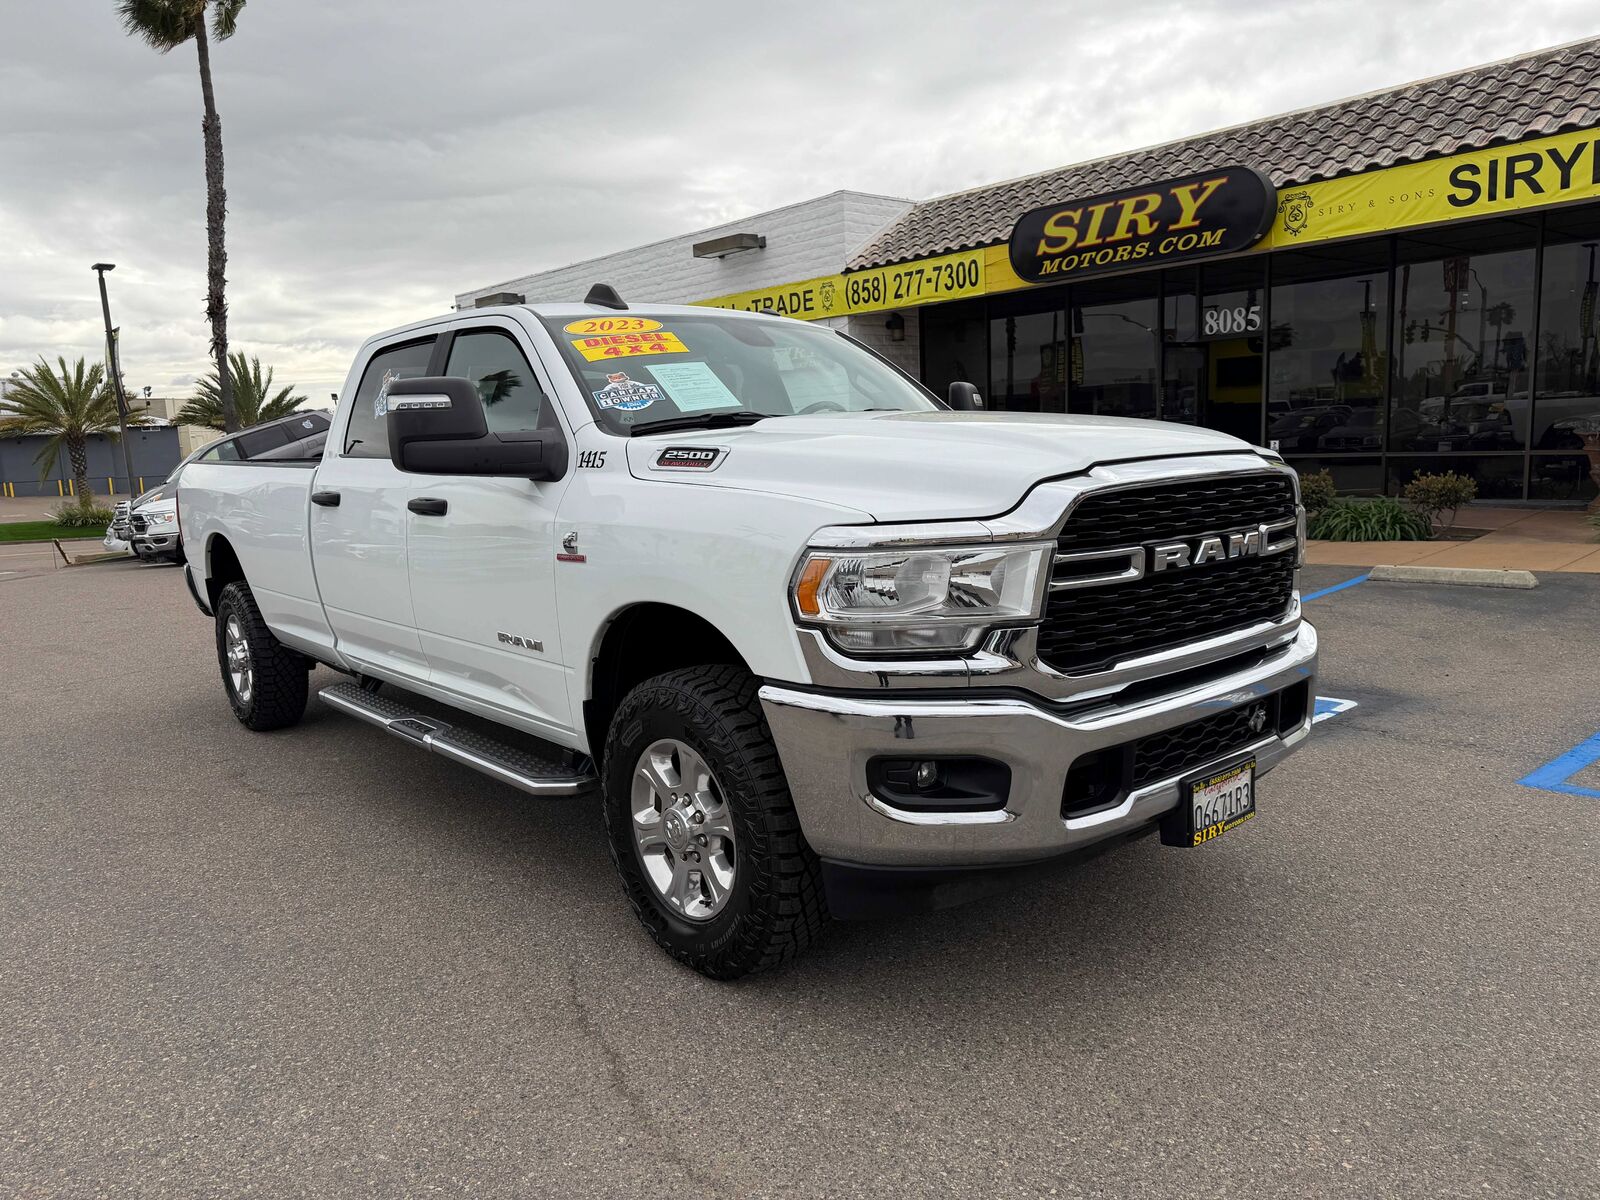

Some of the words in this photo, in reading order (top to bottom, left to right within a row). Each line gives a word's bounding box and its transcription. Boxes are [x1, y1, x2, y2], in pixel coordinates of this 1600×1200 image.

[1447, 140, 1600, 207] SIRY
[1036, 176, 1229, 256] SIRY
[1318, 202, 1356, 217] SIRY
[1368, 199, 1376, 208] &
[1389, 189, 1435, 204] SONS
[1038, 228, 1227, 276] MOTORS.COM
[845, 271, 887, 309] (858)
[893, 259, 979, 300] 277-7300
[583, 319, 645, 333] 2023
[1205, 305, 1261, 335] 8085
[584, 333, 670, 348] DIESEL
[599, 386, 657, 399] CARFAX
[612, 392, 660, 404] OWNER
[578, 450, 608, 469] 1415
[664, 450, 714, 460] 2500
[1154, 531, 1259, 572] RAM
[497, 631, 544, 653] RAM
[1195, 782, 1250, 830] 06671R3
[1193, 820, 1226, 847] SIRY
